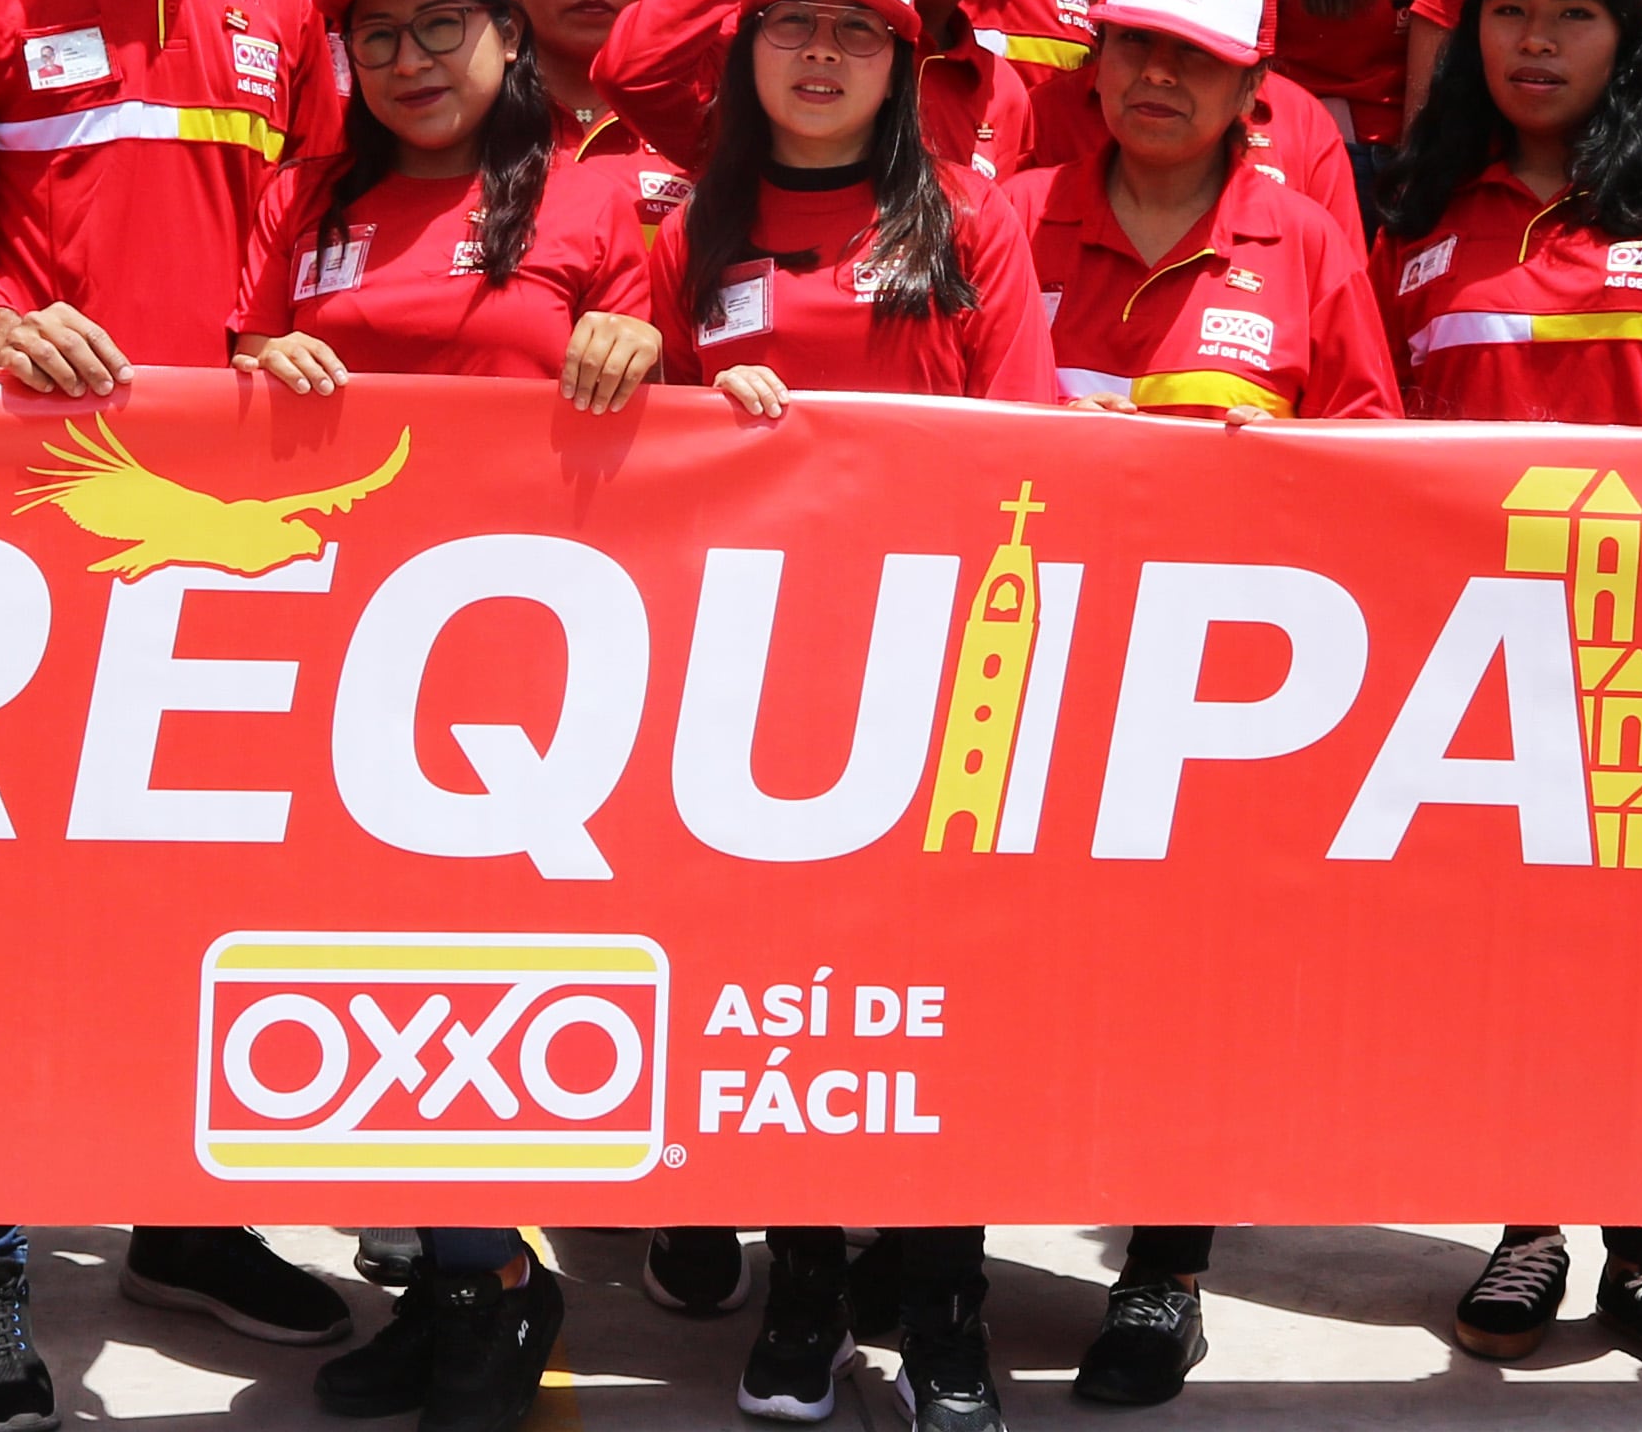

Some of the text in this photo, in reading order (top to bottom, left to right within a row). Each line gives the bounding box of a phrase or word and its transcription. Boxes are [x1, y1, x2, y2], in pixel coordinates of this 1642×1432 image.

[1604, 273, 1626, 288] ASÍ
[1198, 342, 1271, 370] ASÍ DE FÁCIL
[1206, 314, 1270, 346] OXXO
[704, 966, 945, 1038] ASÍ DE
[223, 993, 643, 1120] OXXO
[699, 1047, 940, 1134] FÁCIL
